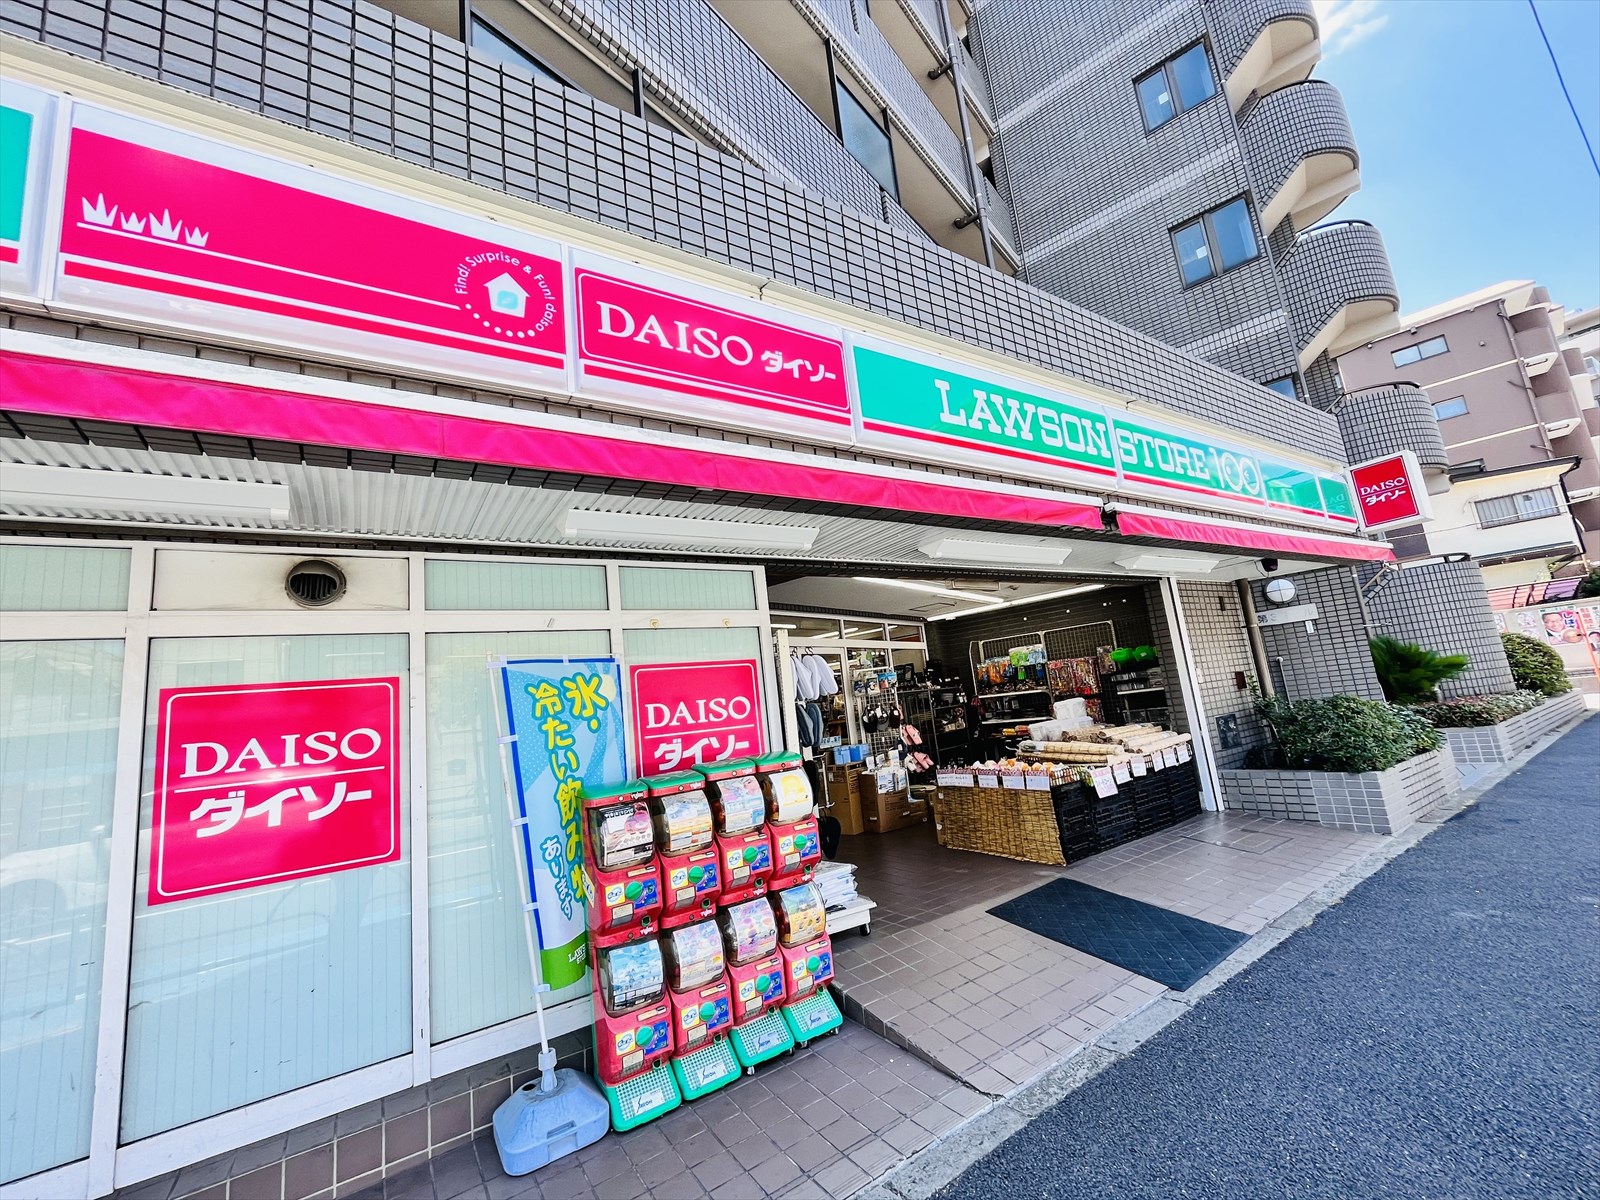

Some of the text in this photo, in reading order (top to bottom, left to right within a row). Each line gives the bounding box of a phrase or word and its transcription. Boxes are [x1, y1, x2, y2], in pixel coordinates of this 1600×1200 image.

[454, 251, 557, 331] Find! Surprise & Fun! daiso
[596, 300, 836, 383] DAISO ダイソー
[934, 378, 1112, 459] LAWSON
[1360, 477, 1405, 495] DAISO
[645, 696, 751, 729] DAISO
[179, 727, 382, 778] DAISO
[654, 734, 749, 771] ダイソー
[189, 781, 372, 839] ダイソー
[544, 838, 572, 918] あります
